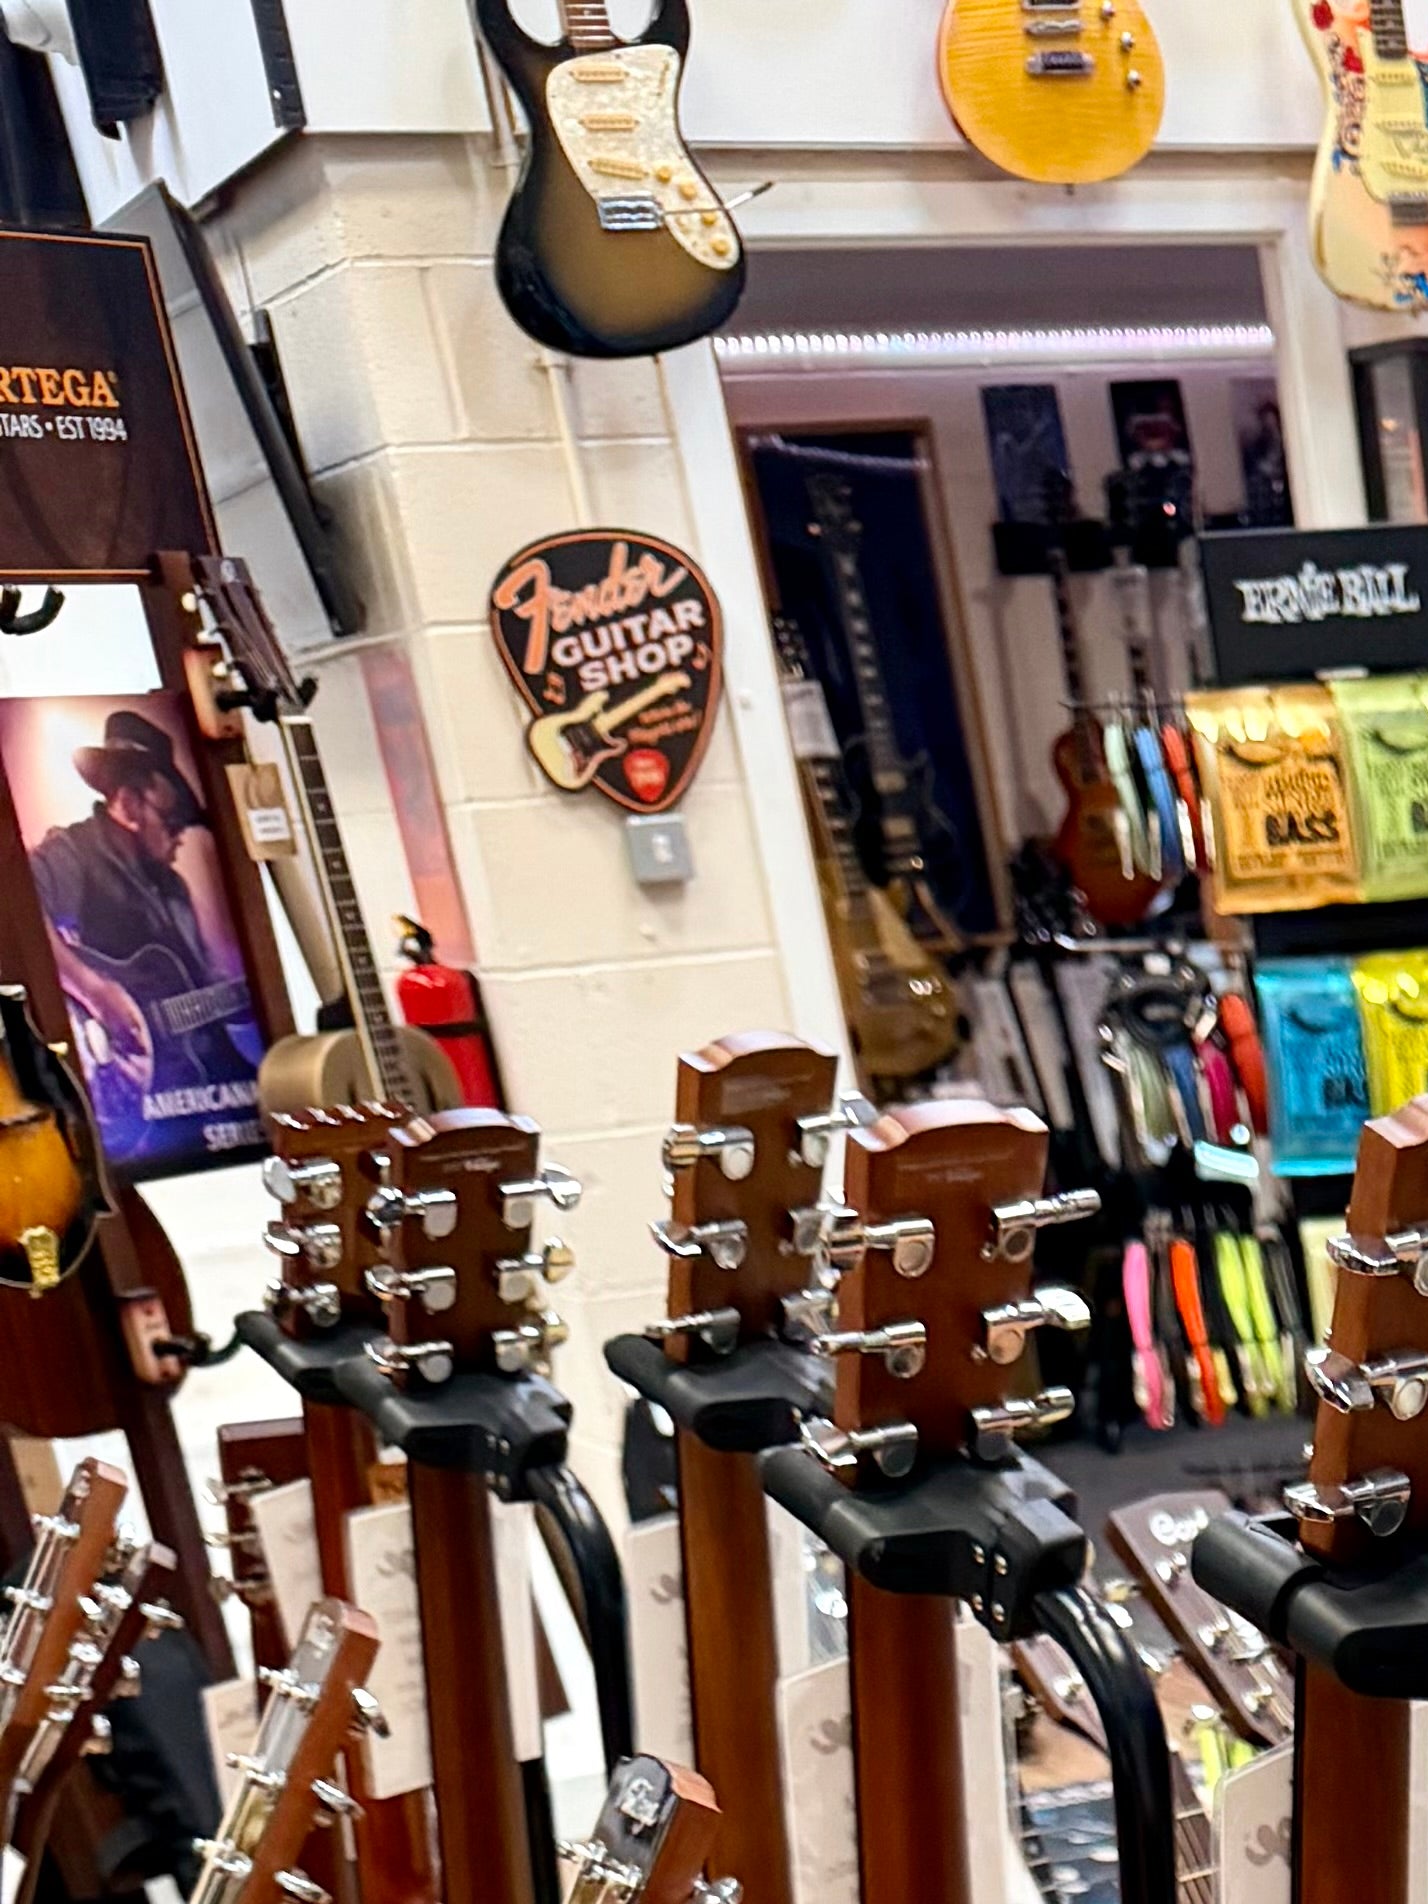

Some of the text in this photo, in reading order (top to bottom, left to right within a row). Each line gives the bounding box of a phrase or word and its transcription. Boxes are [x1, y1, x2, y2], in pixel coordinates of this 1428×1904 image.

[0, 366, 120, 408] RTEGA
[0, 412, 128, 441] TARS EST 1994
[493, 541, 689, 675] Fender
[1234, 559, 1422, 624] ERNIE BALL
[551, 599, 707, 667] GUITAR
[578, 634, 695, 693] SHOP
[143, 1081, 259, 1121] AMERICAN
